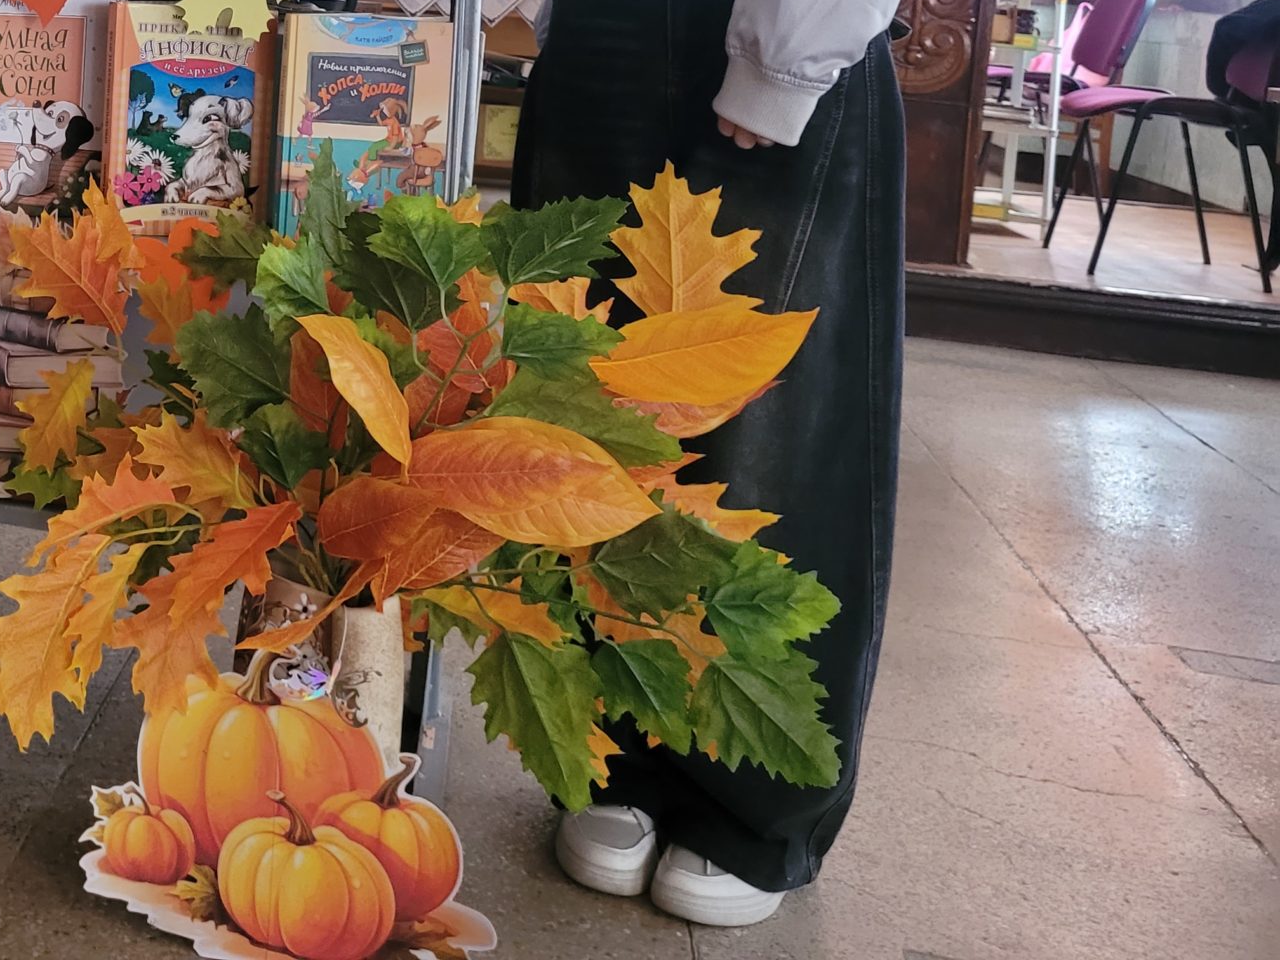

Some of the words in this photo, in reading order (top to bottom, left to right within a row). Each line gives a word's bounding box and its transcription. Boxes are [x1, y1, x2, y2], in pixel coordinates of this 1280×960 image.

[318, 59, 349, 72] Новые
[350, 64, 407, 79] приключения
[0, 71, 56, 98] Соня
[318, 74, 365, 106] ХОПСА
[359, 83, 407, 102] ХОЛЛИ
